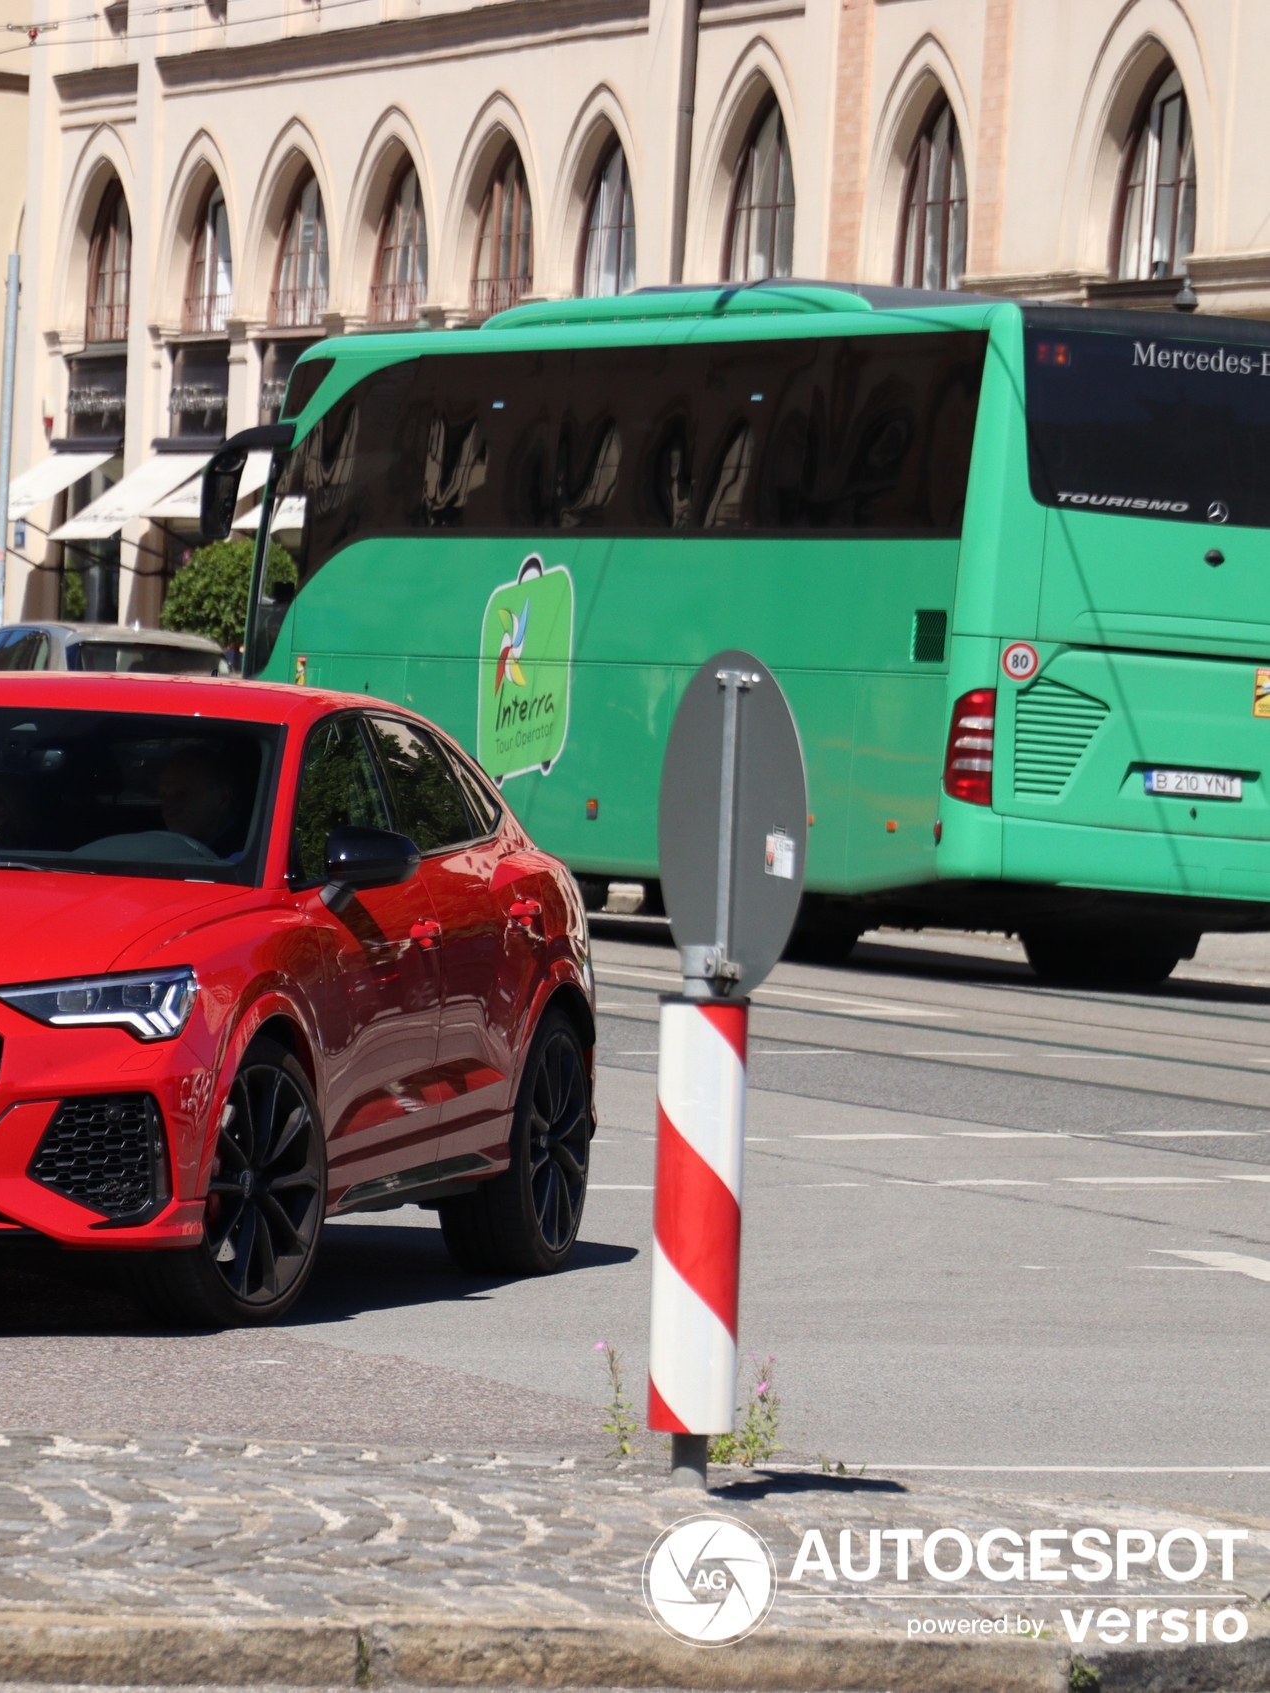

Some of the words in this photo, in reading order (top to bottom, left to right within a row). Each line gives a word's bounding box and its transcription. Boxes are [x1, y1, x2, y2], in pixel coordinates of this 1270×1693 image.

[1056, 491, 1190, 513] TOURISMO
[1011, 653, 1029, 669] 80
[495, 682, 555, 733] Interra
[495, 737, 514, 756] Tour
[515, 722, 554, 750] Operator
[1156, 773, 1168, 789] B
[1174, 774, 1199, 791] 210
